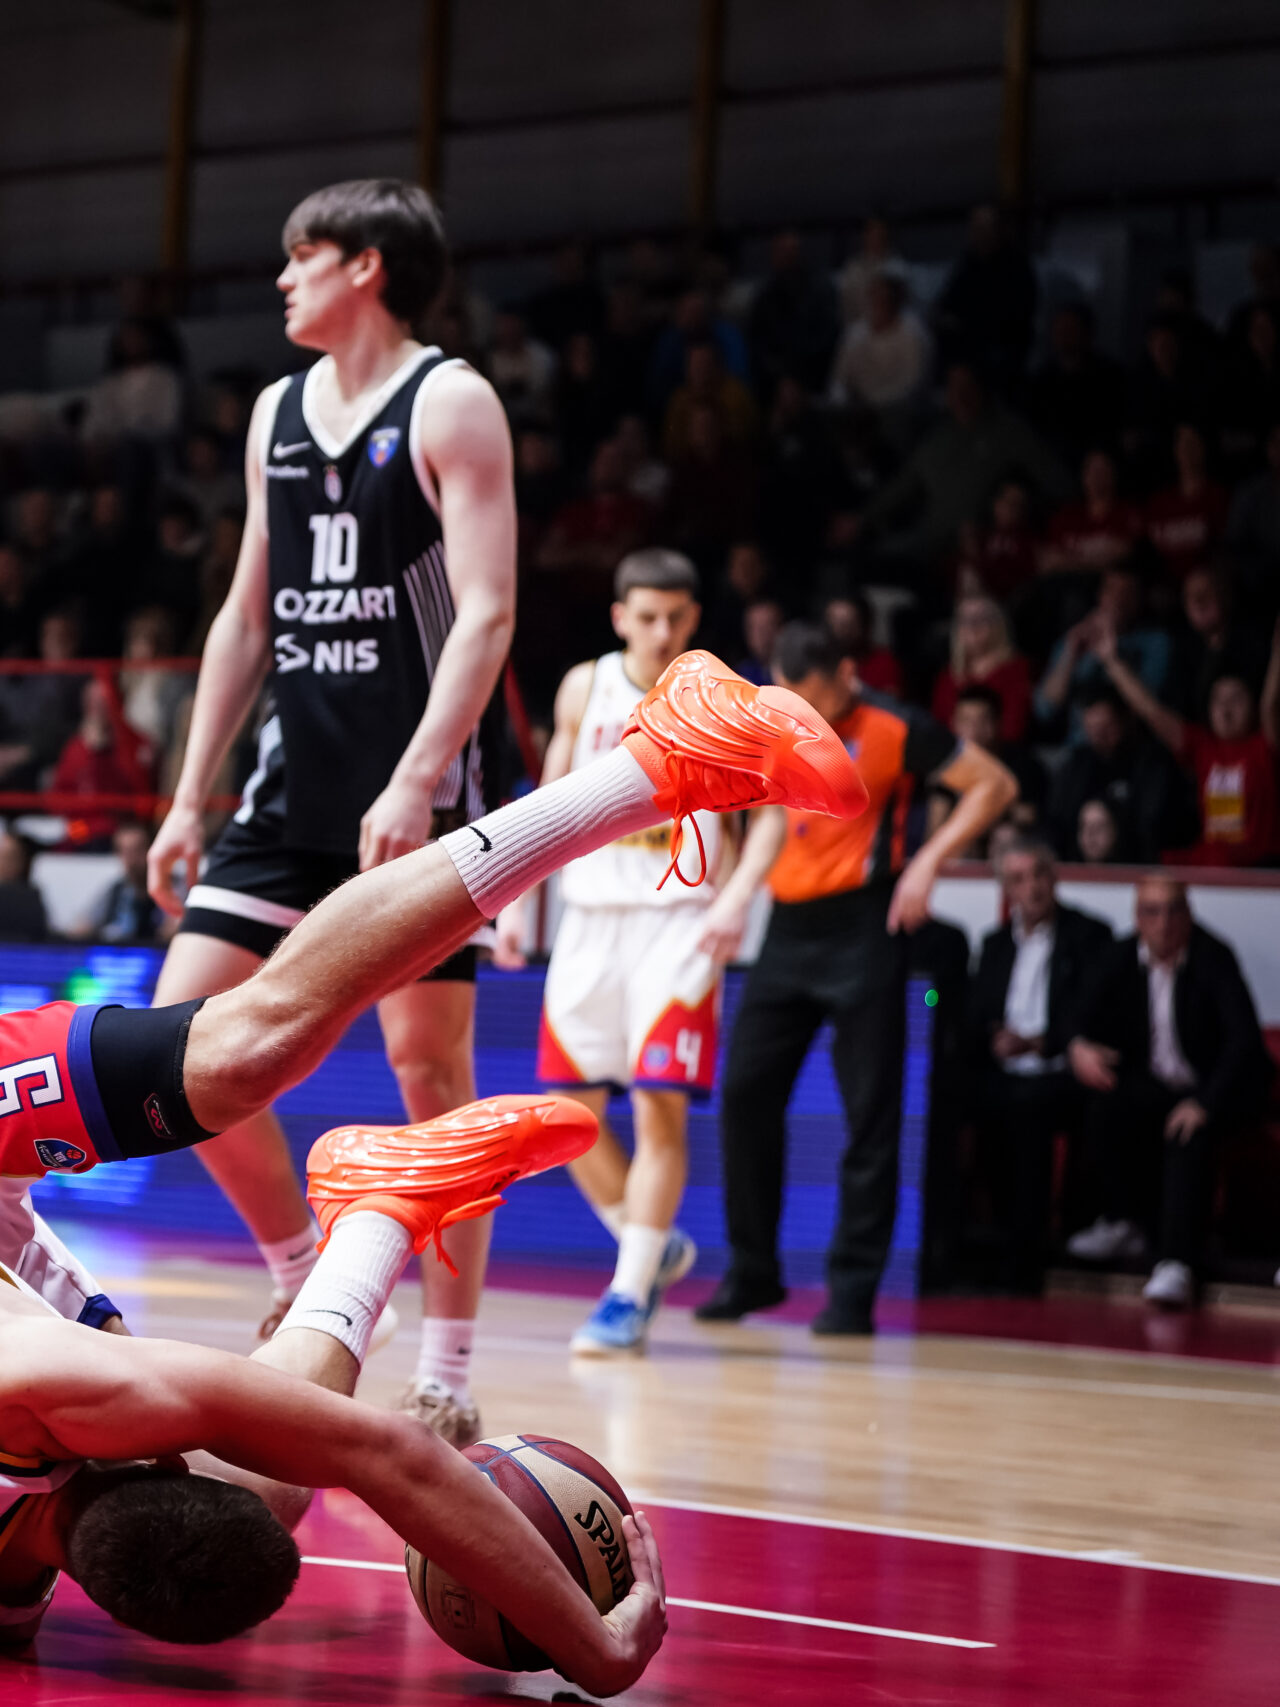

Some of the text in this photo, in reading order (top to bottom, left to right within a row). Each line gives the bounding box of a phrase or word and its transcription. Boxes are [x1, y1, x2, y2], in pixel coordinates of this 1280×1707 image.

[309, 512, 358, 584] 10
[274, 585, 396, 625] OZZART
[313, 639, 379, 674] NIS
[676, 1028, 703, 1082] 4
[574, 1500, 628, 1602] SPALD
